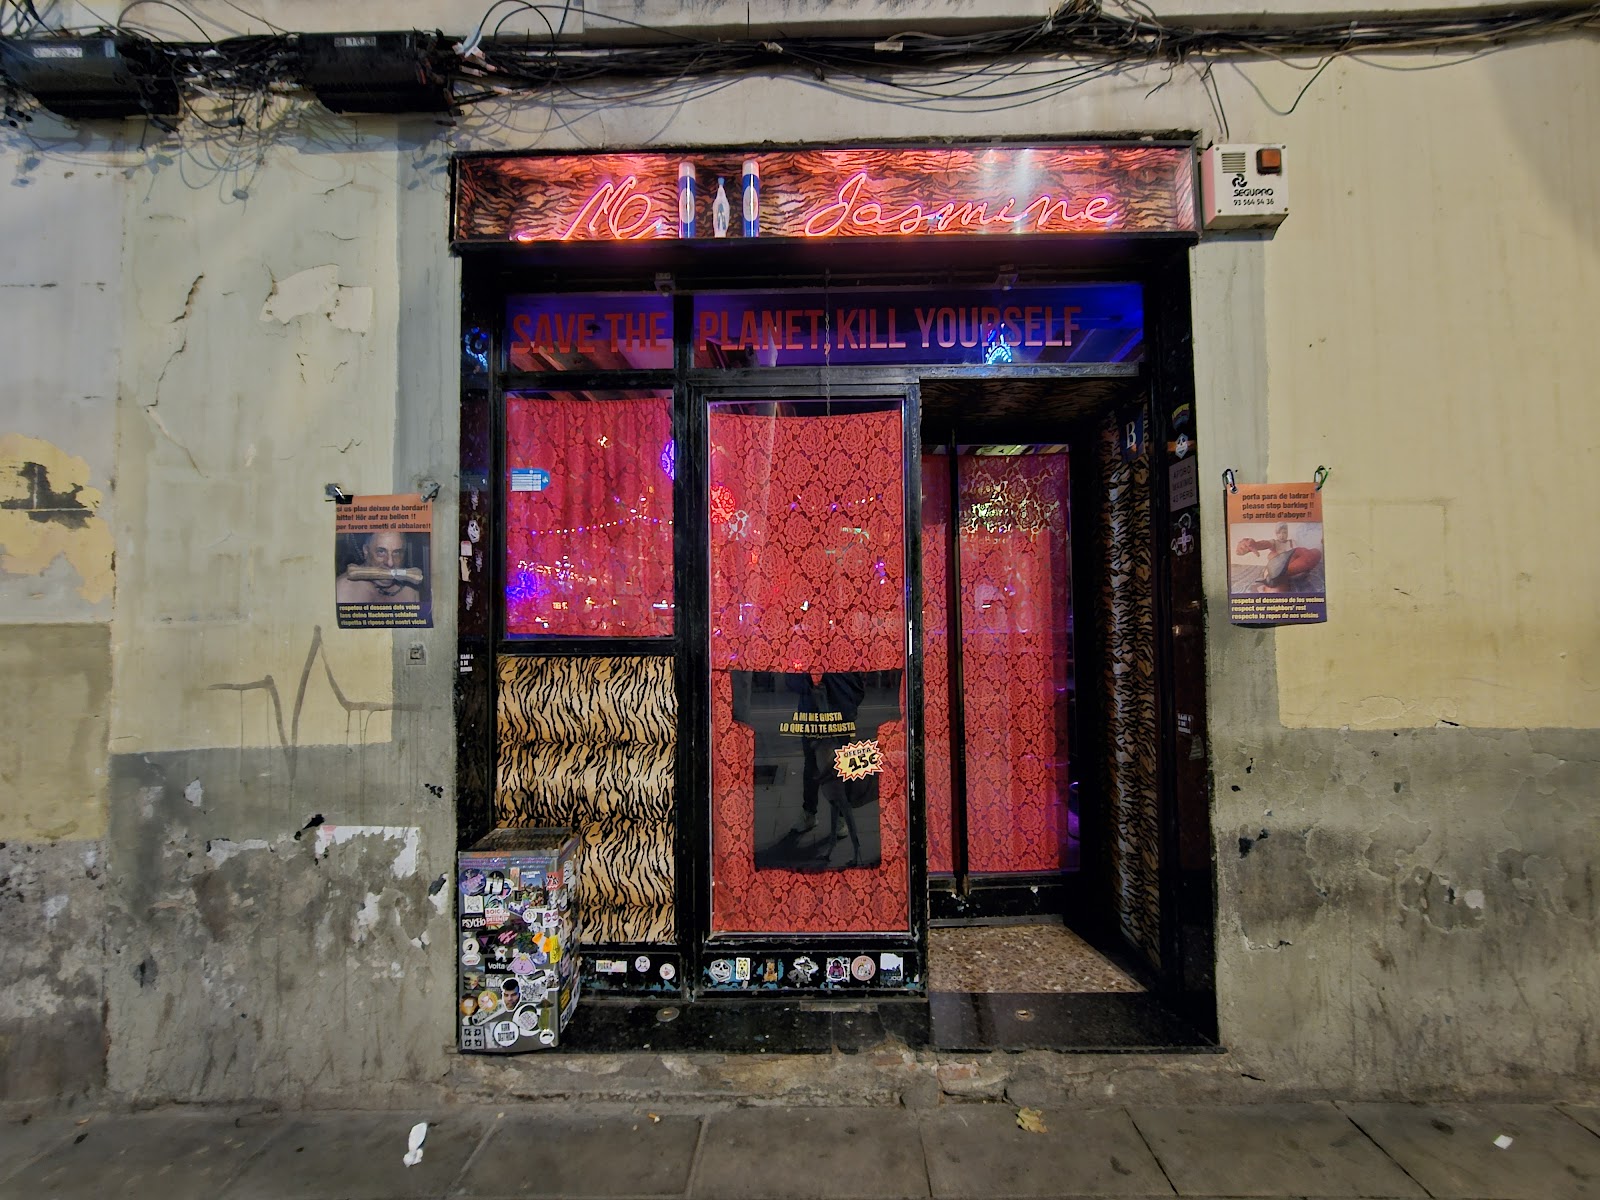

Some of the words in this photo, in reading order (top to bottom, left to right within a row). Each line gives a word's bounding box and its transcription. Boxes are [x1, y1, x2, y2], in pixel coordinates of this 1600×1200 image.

[1233, 188, 1274, 197] SEGUPRO
[804, 171, 1119, 237] Jasmine
[512, 313, 596, 354] SAVE
[604, 311, 668, 353] THE
[836, 308, 906, 349] KILL
[914, 306, 1082, 348] YOURSELF
[793, 712, 799, 721] A
[799, 713, 808, 721] MI
[820, 712, 843, 721] GUSTA
[780, 723, 789, 732] LO
[790, 723, 804, 733] QUE
[805, 723, 810, 733] A
[810, 724, 818, 733] TI
[818, 724, 828, 733] TE
[828, 722, 856, 733] ASUSTA
[844, 748, 872, 758] OFERTA
[461, 917, 486, 928] PSYCHO
[487, 962, 506, 970] Volta
